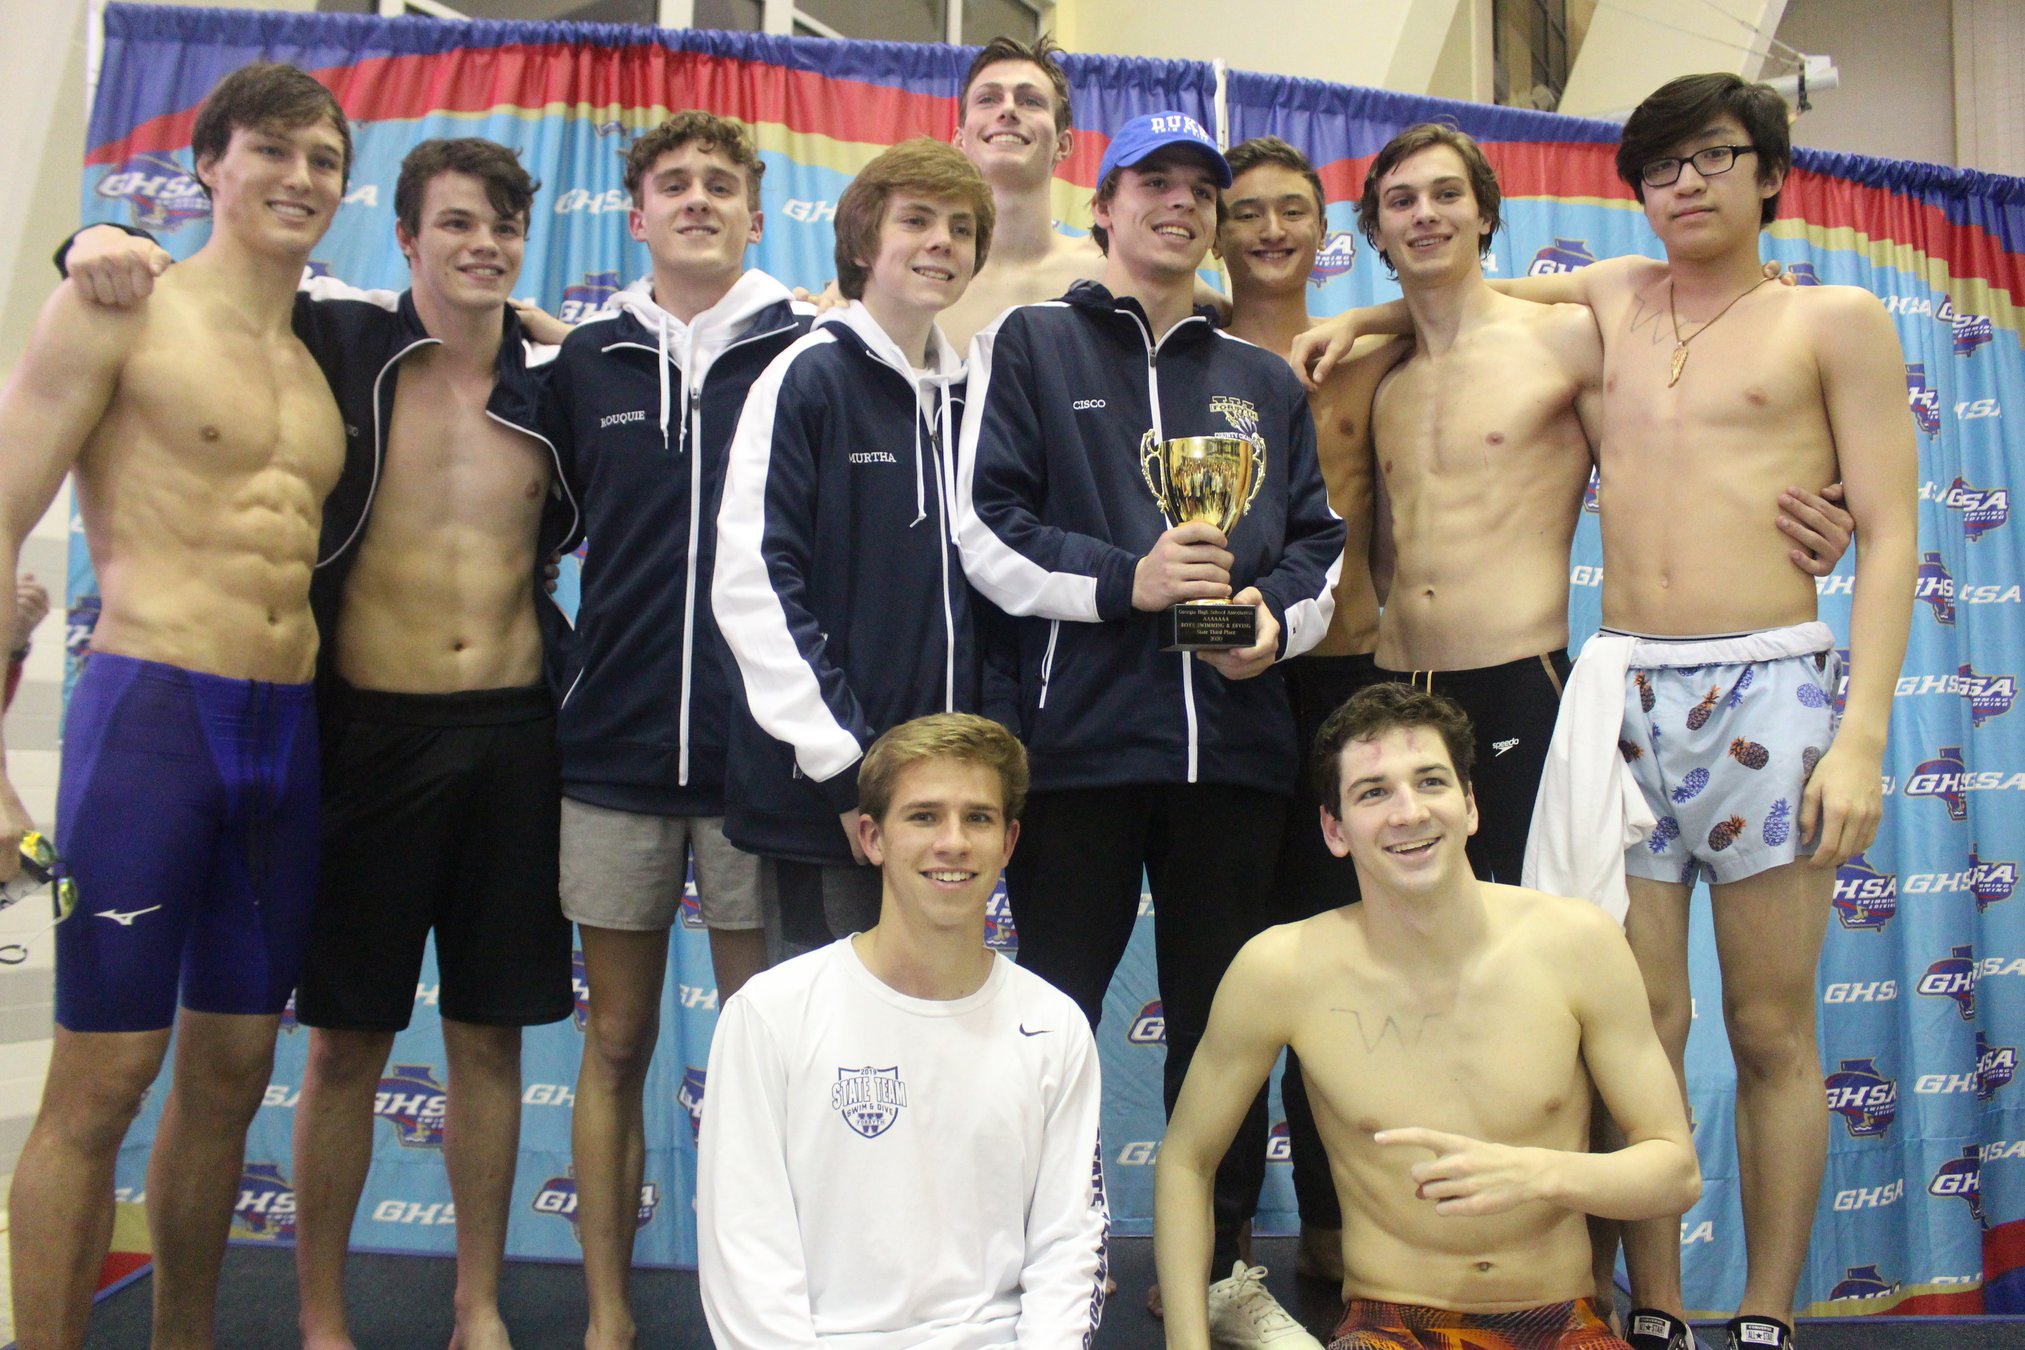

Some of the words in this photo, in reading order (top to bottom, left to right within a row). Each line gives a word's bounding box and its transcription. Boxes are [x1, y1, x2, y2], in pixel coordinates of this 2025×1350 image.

[1150, 115, 1209, 140] DUKE
[782, 199, 837, 222] GH
[1529, 260, 1585, 276] GH
[1072, 399, 1106, 410] CISCO
[600, 410, 645, 428] ROUQUIE
[849, 451, 897, 463] MURTHA
[1894, 675, 1960, 696] GHS
[1492, 737, 1520, 750] speedo
[1832, 878, 1897, 899] HSA
[1903, 871, 1971, 894] GHS
[1918, 971, 1975, 994] GH
[860, 1068, 877, 1076] 2019
[521, 1084, 575, 1107] GH
[831, 1076, 870, 1110] STATE
[874, 1076, 908, 1107] TEAM
[847, 1104, 867, 1117] SWIM
[877, 1103, 894, 1116] DIVE
[1979, 1139, 2025, 1163] HSA
[1931, 1169, 1981, 1195] GH
